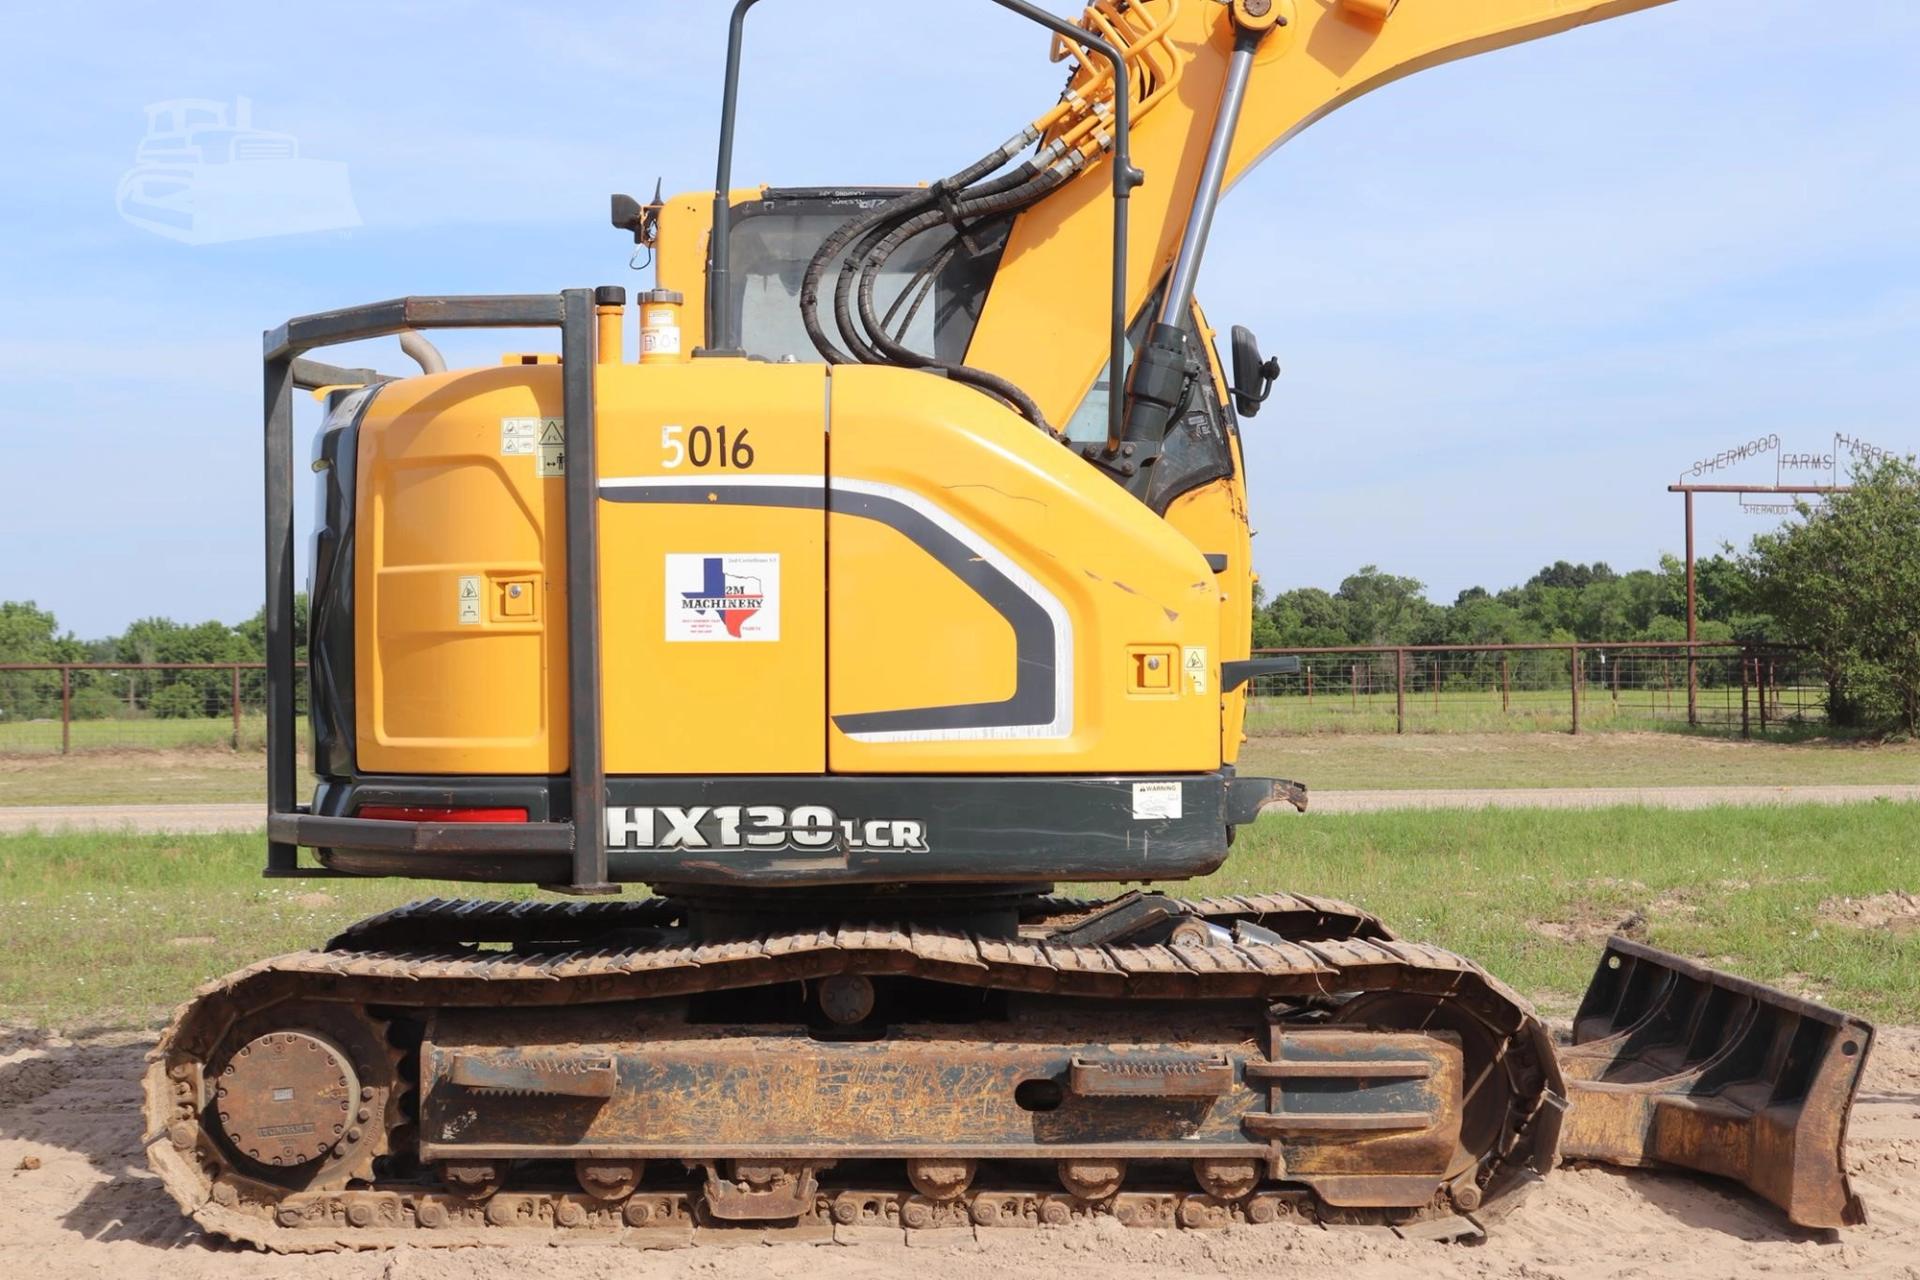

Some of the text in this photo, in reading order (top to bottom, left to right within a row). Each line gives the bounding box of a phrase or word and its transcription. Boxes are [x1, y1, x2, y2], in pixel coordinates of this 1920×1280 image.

[661, 425, 754, 469] 5016
[1691, 433, 1779, 477] SHERWOOD
[1781, 454, 1833, 470] FARMS
[1743, 504, 1788, 515] SHERWOOD
[725, 585, 745, 595] 2M
[681, 598, 764, 609] MACHINERY
